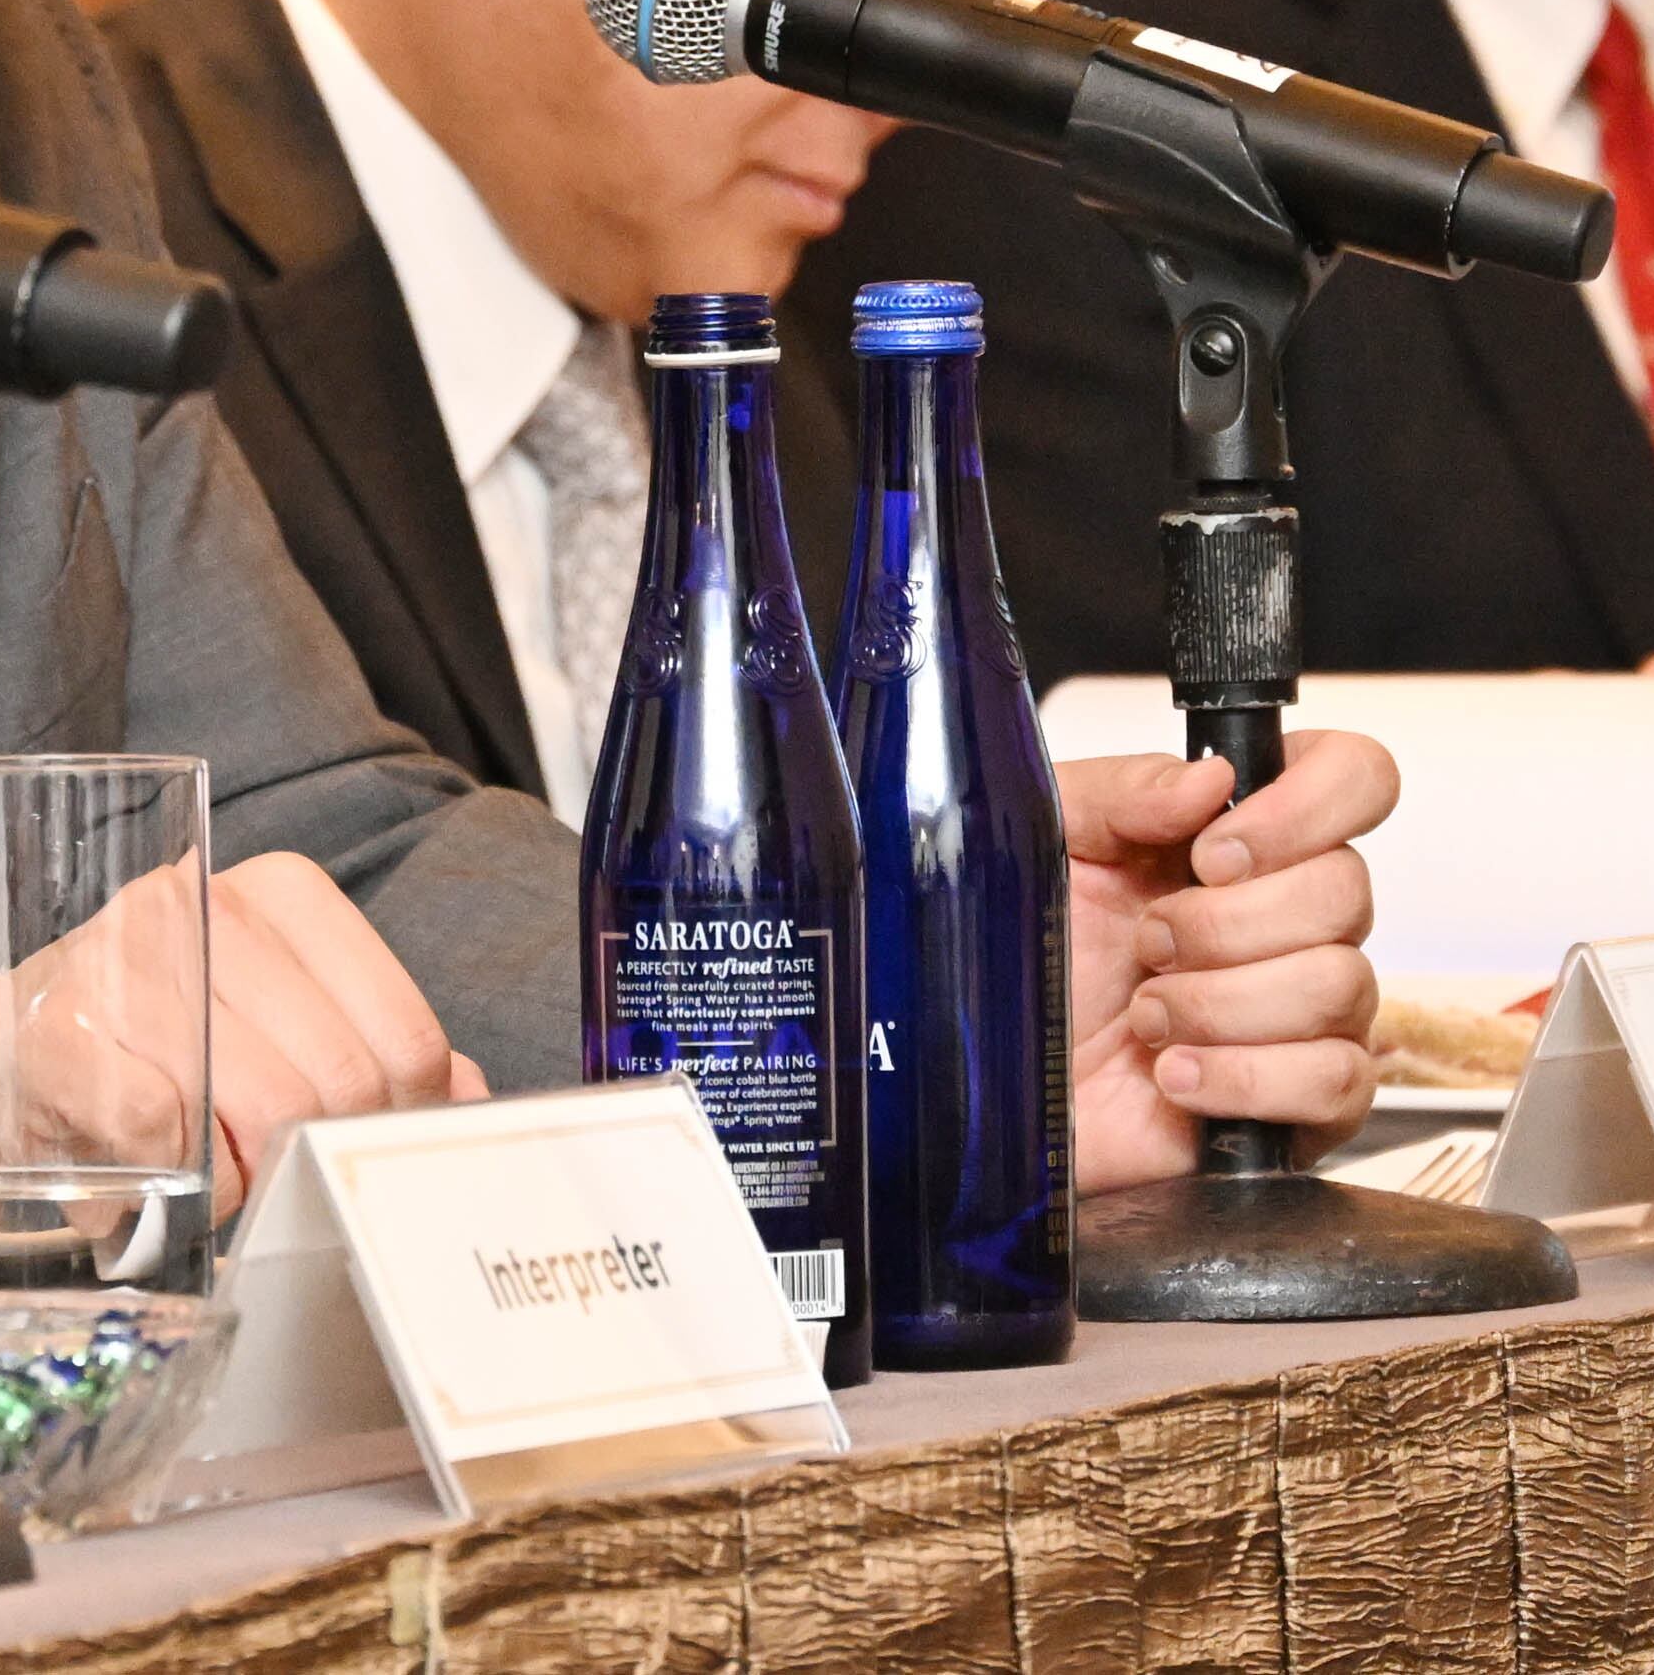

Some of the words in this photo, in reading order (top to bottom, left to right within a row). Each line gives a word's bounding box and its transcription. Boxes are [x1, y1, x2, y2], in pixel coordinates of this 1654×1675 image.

[616, 961, 624, 975] A
[627, 961, 697, 975] PERFECTLY
[702, 956, 772, 979] refined
[775, 959, 815, 973] TASTE
[617, 980, 651, 992] Sourced
[654, 980, 678, 991] from
[681, 979, 729, 994] carefully
[733, 978, 774, 990] curated
[666, 994, 701, 1007] Spring
[705, 994, 740, 1005] Water
[745, 993, 764, 1004] has
[777, 992, 815, 1003] smooth
[617, 1008, 639, 1018] taste
[642, 1007, 663, 1018] that
[666, 1006, 737, 1021] effortlessly
[741, 1006, 815, 1018] complements
[651, 1020, 672, 1032] fine
[676, 1020, 708, 1031] meals
[712, 1020, 732, 1031] and
[618, 1057, 663, 1072] LIFE'S
[744, 1054, 816, 1070] PAIRING
[705, 1075, 733, 1087] iconic
[736, 1074, 766, 1086] cobalt
[769, 1073, 788, 1084] blue
[791, 1072, 816, 1083] bottle
[729, 1087, 740, 1098] of
[742, 1087, 798, 1098] celebrations
[800, 1086, 816, 1097] that
[727, 1102, 777, 1114] Experience
[780, 1101, 816, 1113] exquisite
[744, 1115, 773, 1128] Spring
[728, 1143, 764, 1154] WATER
[766, 1142, 794, 1153] SINCE
[797, 1141, 814, 1151] 1872
[474, 1234, 671, 1316] Interpreter
